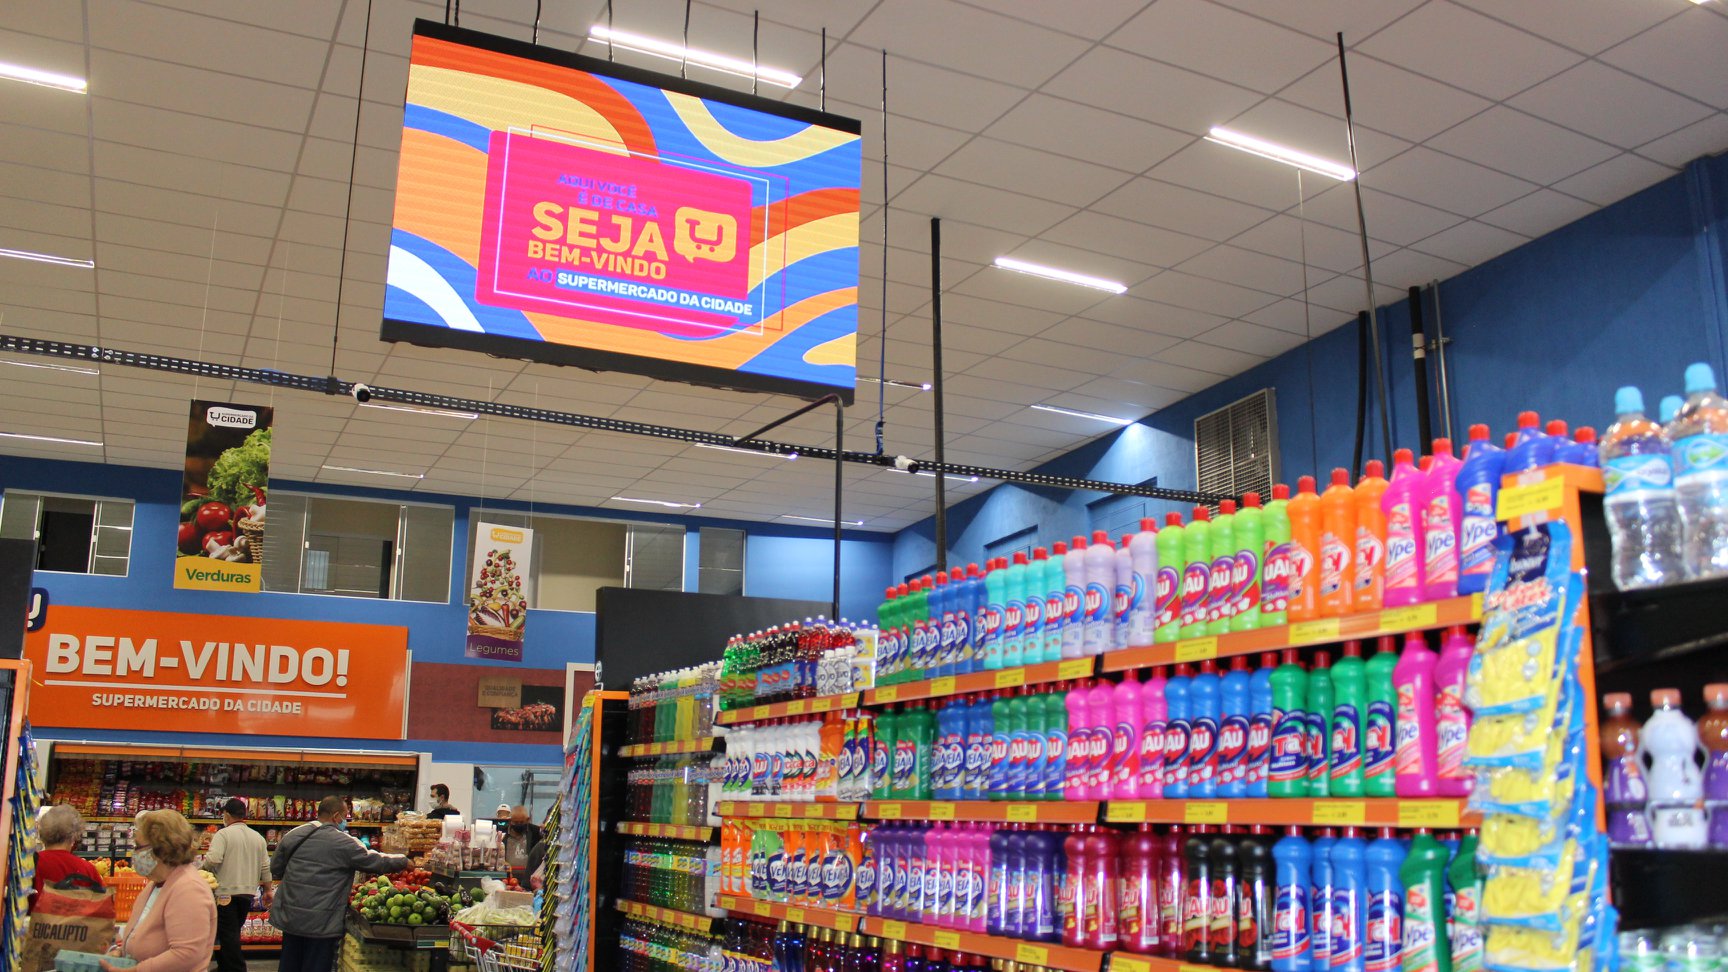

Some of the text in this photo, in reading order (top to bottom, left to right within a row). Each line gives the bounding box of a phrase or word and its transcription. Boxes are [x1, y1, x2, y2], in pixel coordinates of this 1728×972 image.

[557, 173, 595, 189] AQUI
[591, 194, 613, 209] DE
[616, 199, 657, 217] CASA
[531, 201, 669, 261] SEJA
[527, 239, 667, 279] BEM-VINDO
[528, 267, 753, 316] AO SUPERMERCADO DA CIDADE
[221, 416, 254, 425] CIDADE
[185, 568, 251, 584] Verduras
[469, 642, 519, 656] Legumes
[45, 633, 350, 687] BEM-VINDO!
[92, 693, 302, 714] SUPERMERCADO DA CIDADE
[33, 922, 88, 942] EUCALIPTO
